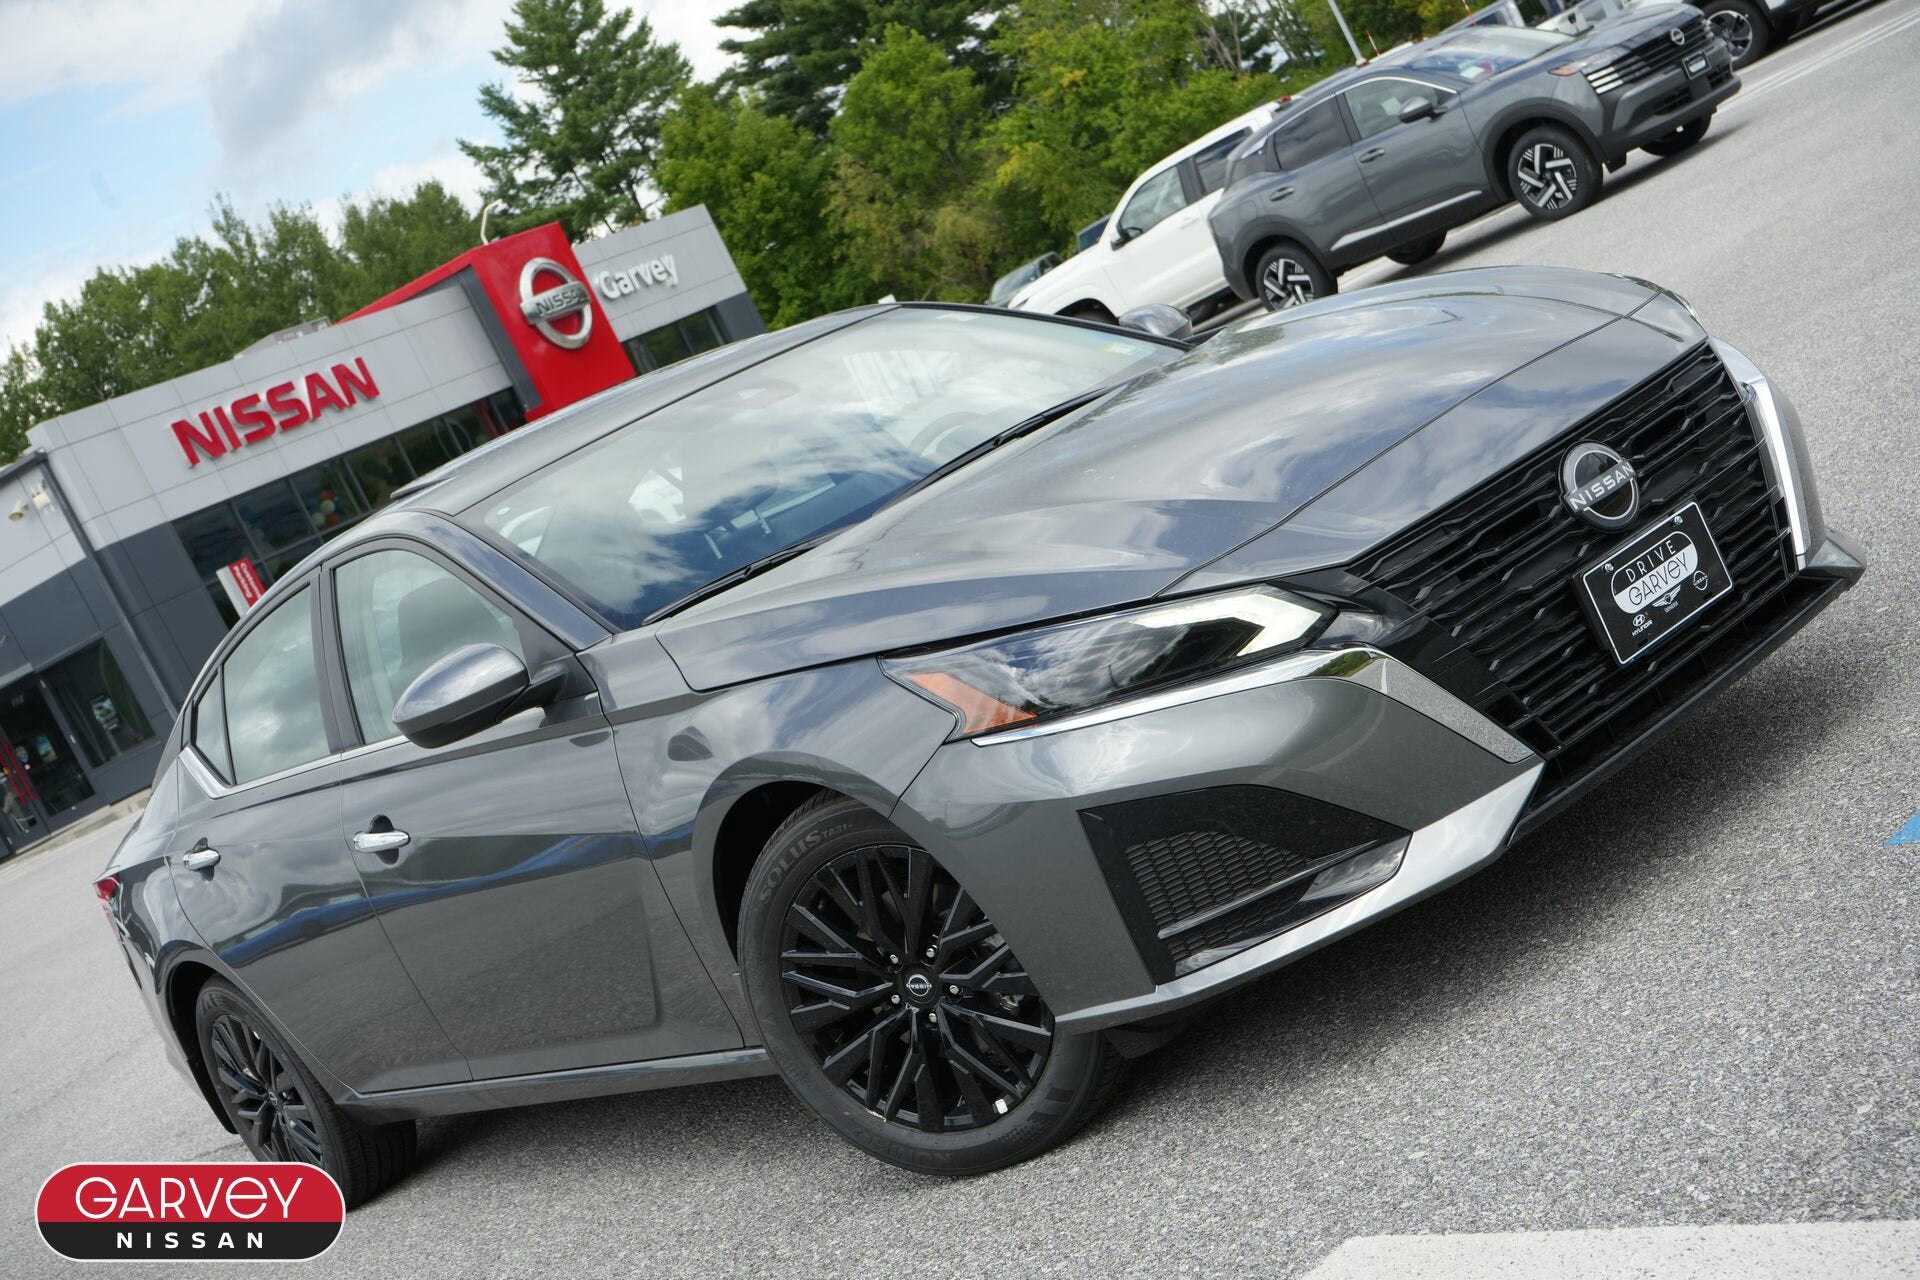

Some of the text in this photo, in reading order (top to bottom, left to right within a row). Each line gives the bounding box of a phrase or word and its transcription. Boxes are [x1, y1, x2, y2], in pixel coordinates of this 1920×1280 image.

[600, 254, 678, 298] Garvey
[171, 357, 380, 467] NISSAN
[1569, 461, 1634, 510] NISSAN
[1625, 540, 1676, 583] DRIVE
[759, 830, 821, 904] SOLUS
